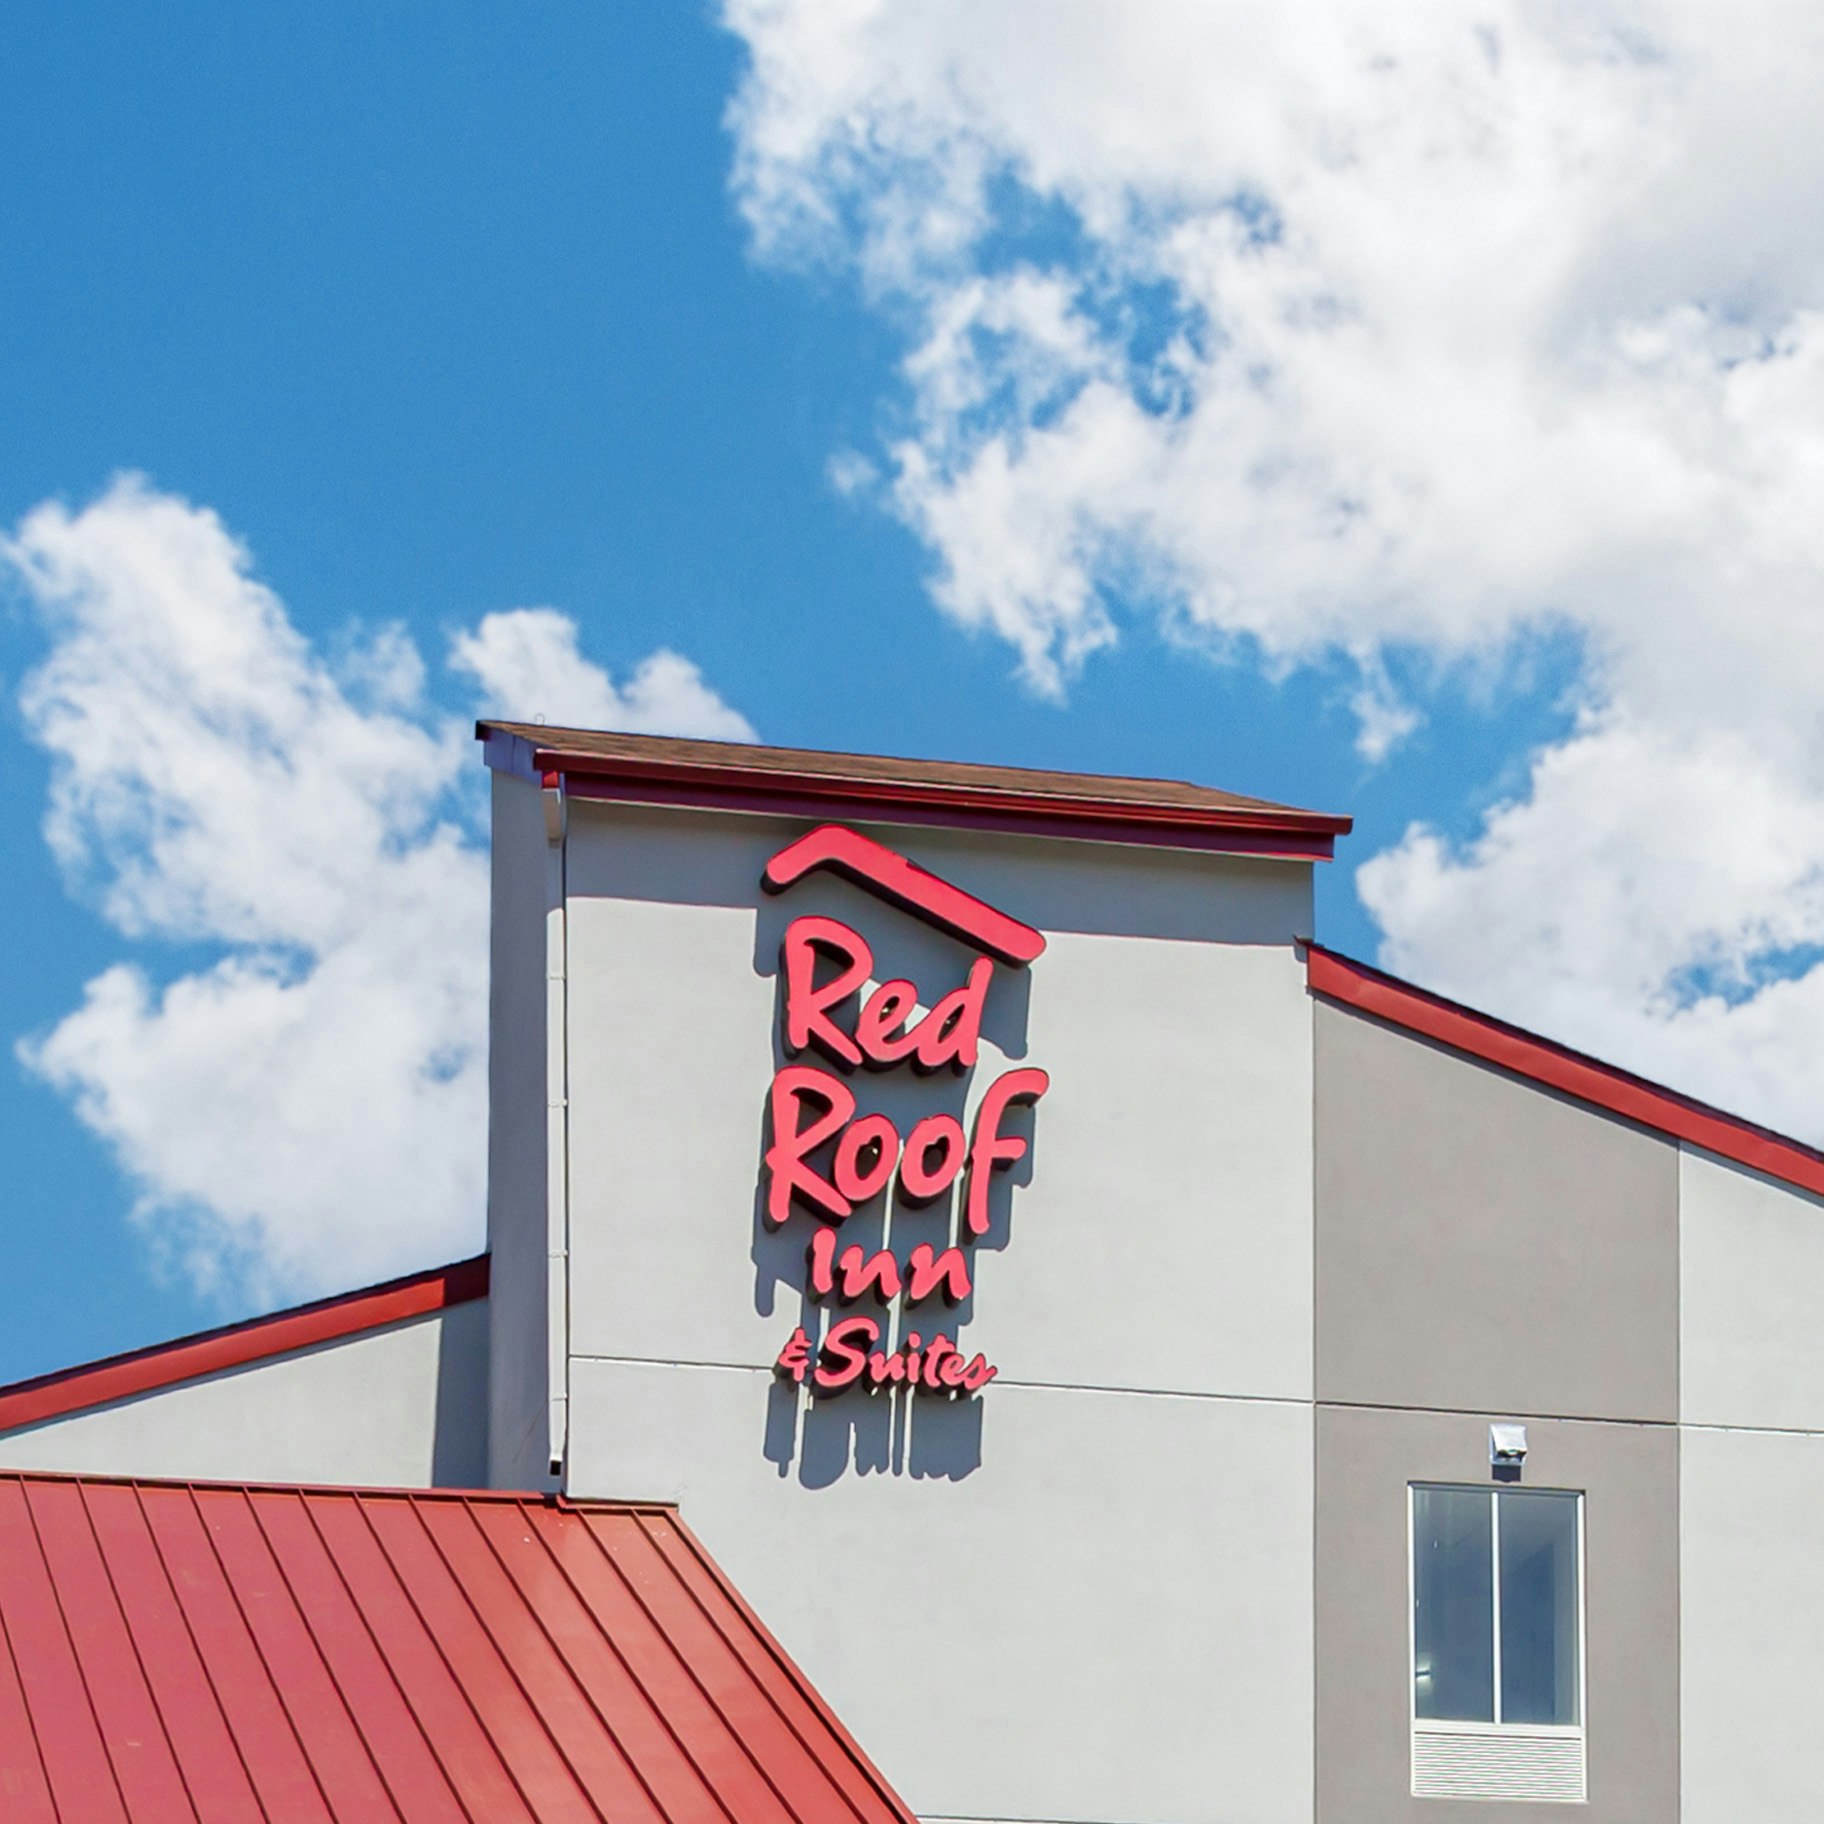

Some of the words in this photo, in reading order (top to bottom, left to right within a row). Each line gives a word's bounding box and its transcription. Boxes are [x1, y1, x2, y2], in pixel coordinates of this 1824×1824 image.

[784, 915, 993, 1067] Red
[766, 1065, 1050, 1236] Roof
[809, 1227, 972, 1302] Inn
